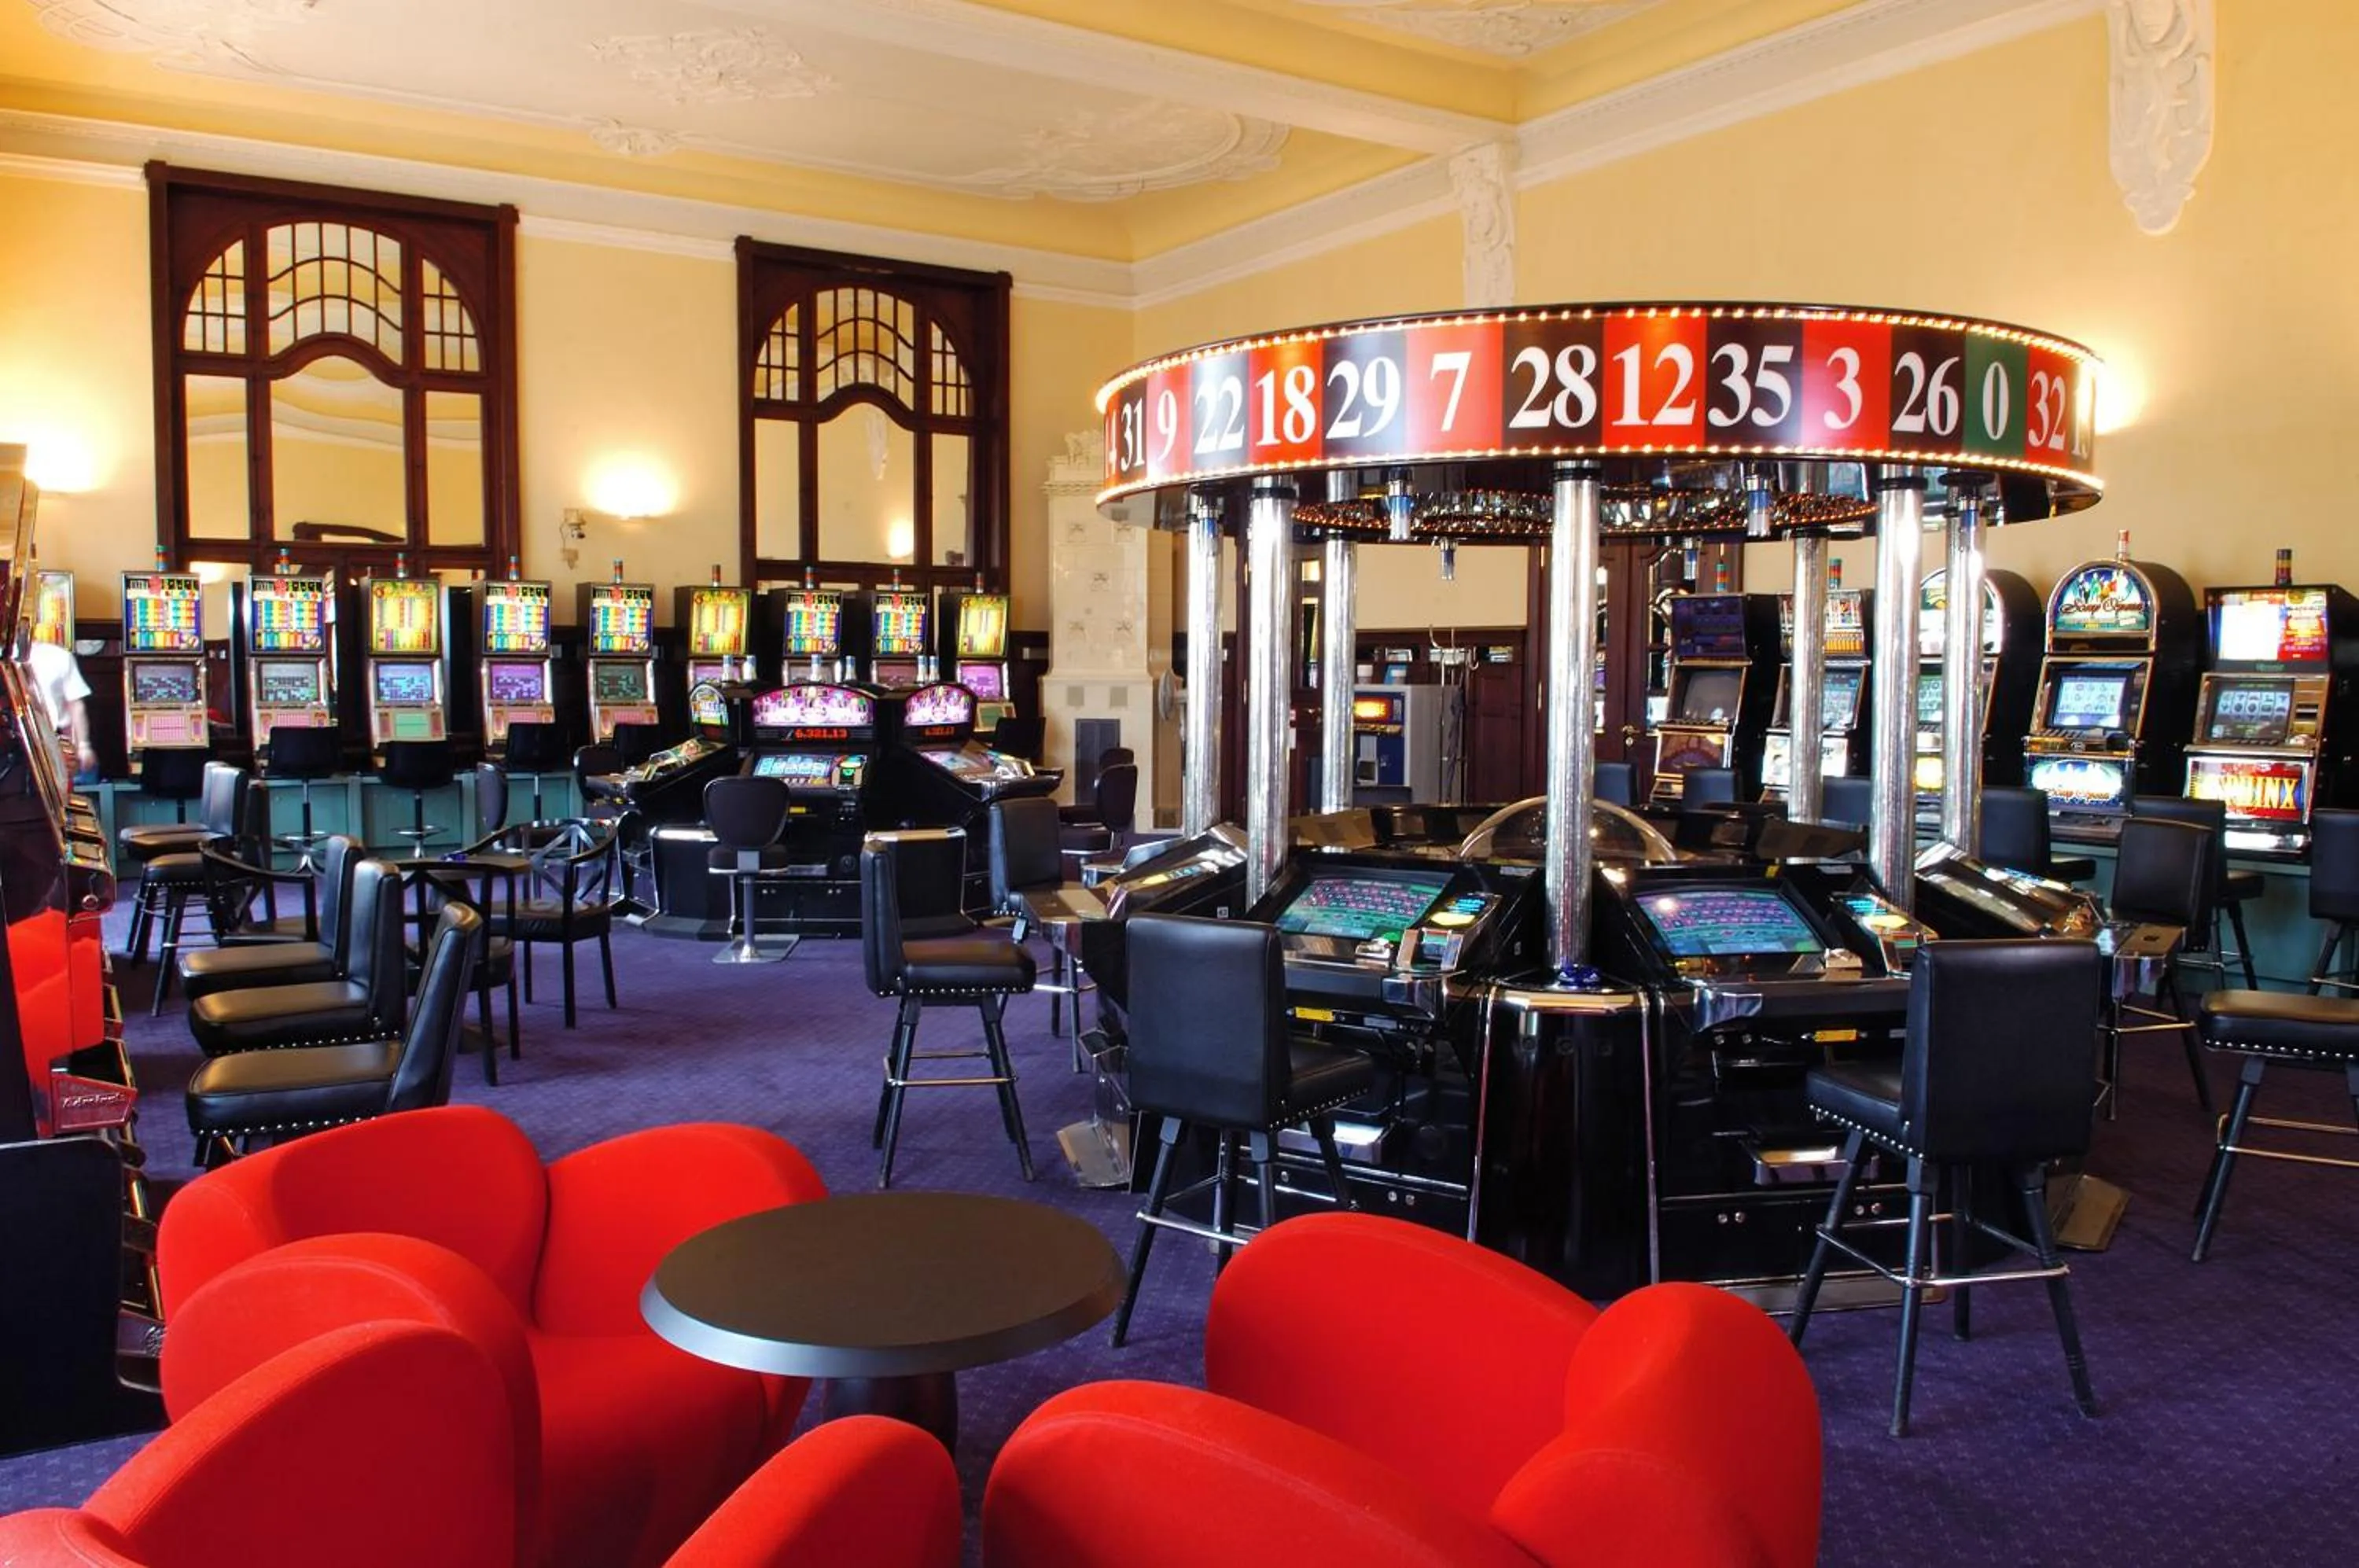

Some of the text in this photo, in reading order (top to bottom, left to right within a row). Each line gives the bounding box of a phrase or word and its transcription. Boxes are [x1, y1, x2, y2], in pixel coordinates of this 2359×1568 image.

[1120, 397, 1145, 472] 31
[1157, 388, 1177, 462] 9
[1193, 375, 1245, 454] 22
[1255, 365, 1316, 446] 18
[1327, 356, 1401, 439] 29
[1430, 352, 1471, 432] 7
[1510, 344, 1597, 428] 28
[1612, 343, 1697, 426] 12
[1708, 343, 1794, 426] 35
[1823, 347, 1863, 429] 3
[1891, 352, 1960, 436] 26
[1982, 361, 2009, 441] 0
[2028, 370, 2065, 451] 32
